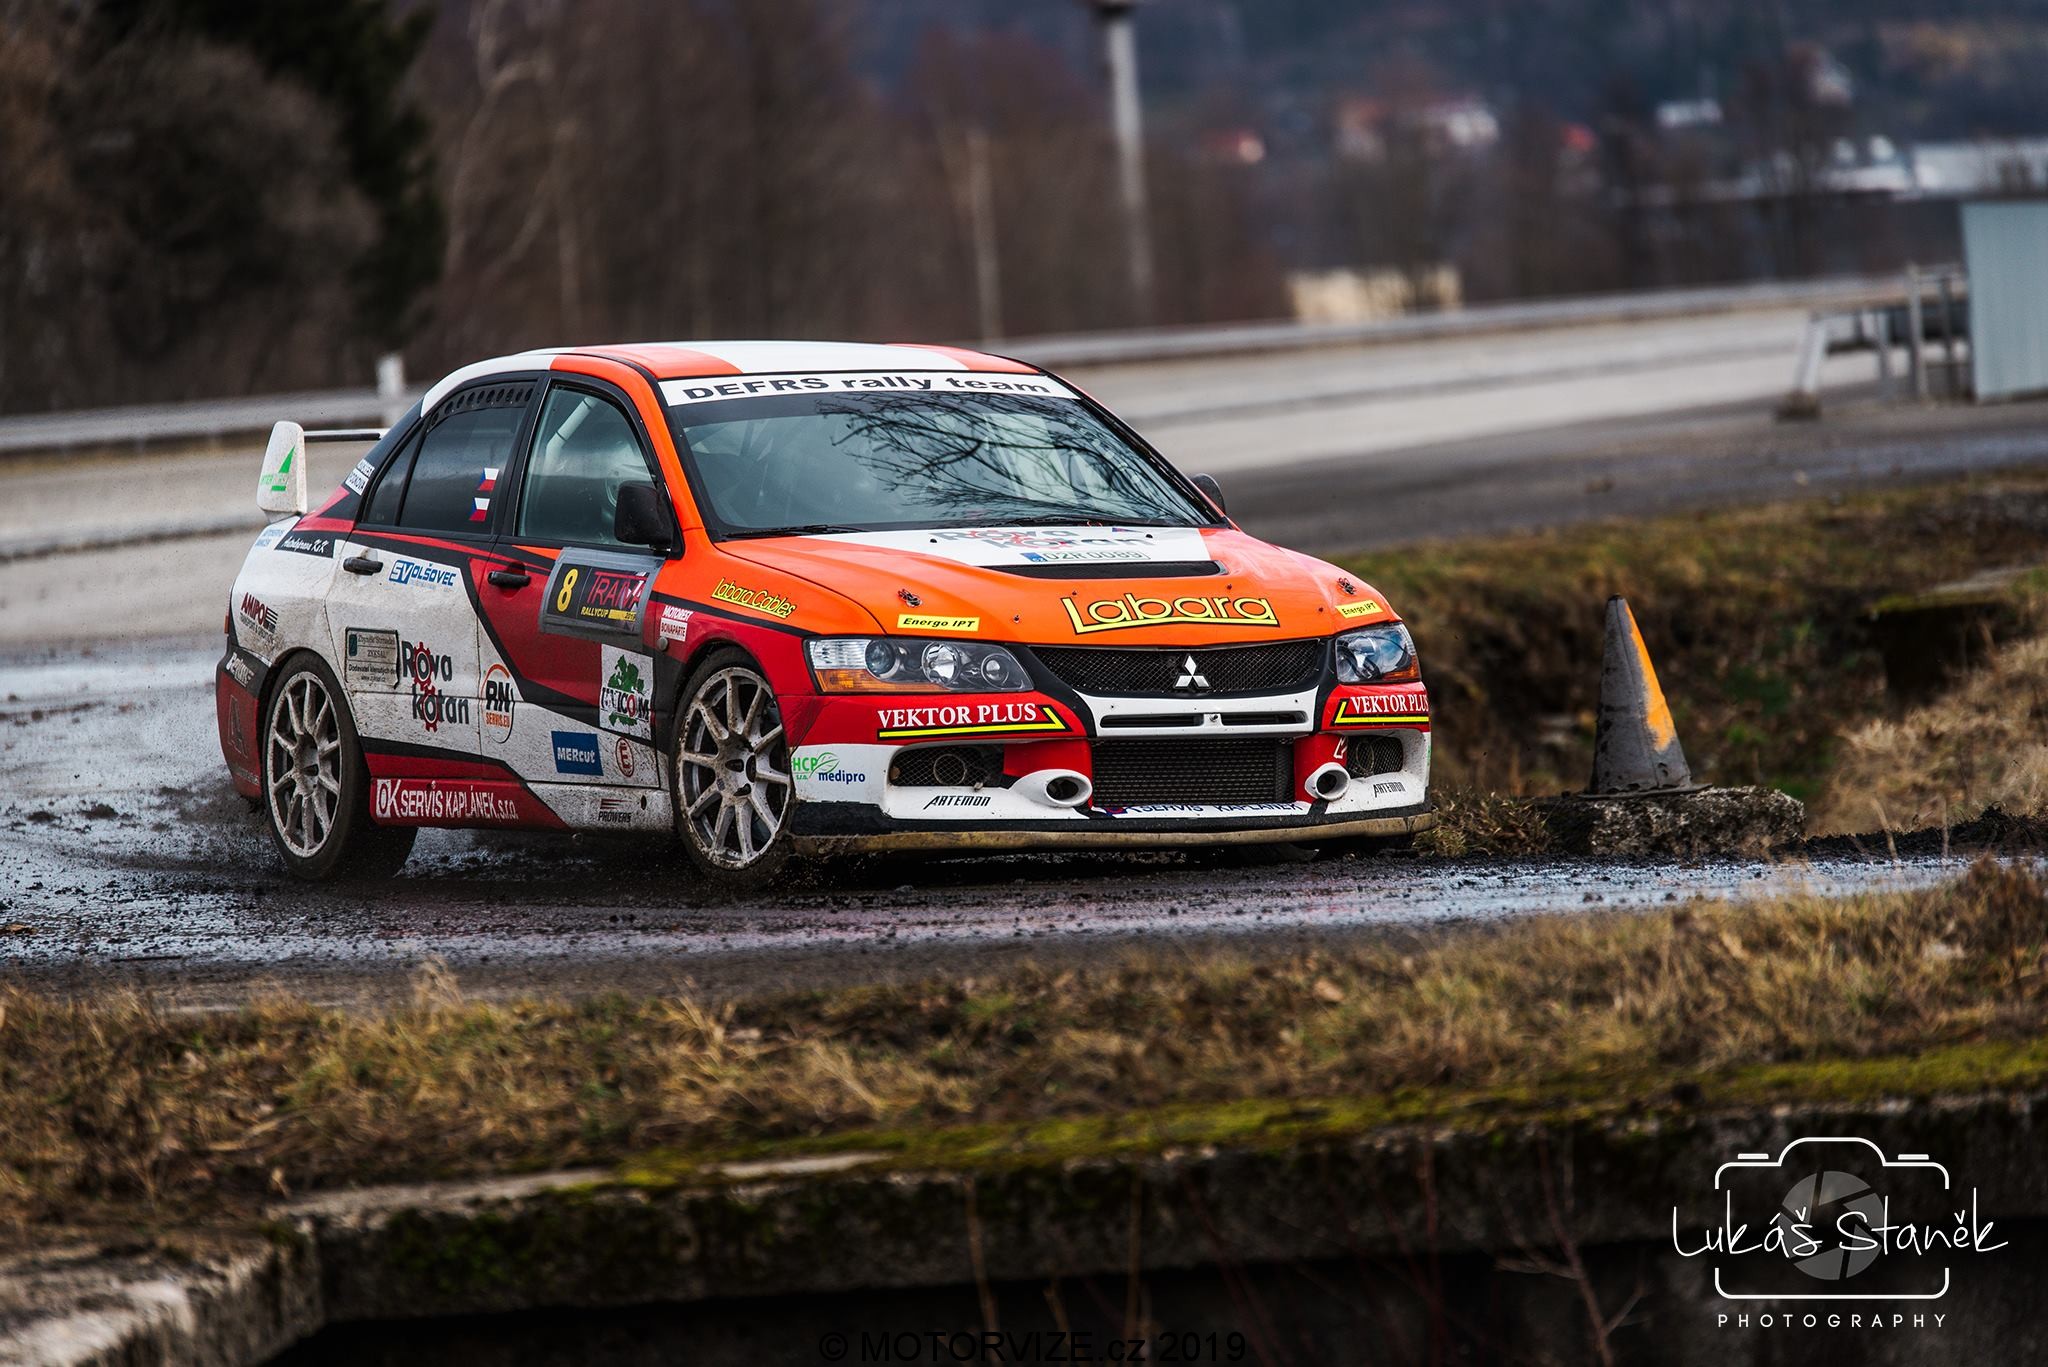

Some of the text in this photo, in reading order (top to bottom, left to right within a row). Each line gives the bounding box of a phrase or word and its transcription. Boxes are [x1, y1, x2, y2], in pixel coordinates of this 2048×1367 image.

[683, 376, 1051, 399] DEFRS rally team
[411, 562, 457, 586] OLŠOVEC
[556, 568, 579, 612] 8
[711, 577, 797, 616] Labara Cables
[580, 606, 609, 618] RALLYCUP
[903, 617, 976, 628] Energo IPT
[1061, 593, 1280, 634] Labara
[402, 641, 453, 682] Rova
[412, 683, 469, 724] kotan
[486, 680, 510, 712] RN
[1350, 694, 1429, 714] VEKTOR PLUS
[878, 702, 1037, 728] VEKTOR PLUS
[792, 757, 818, 771] HCP
[818, 769, 866, 785] medipro
[400, 789, 443, 818] SERVIS
[923, 795, 991, 810] ARTEMON
